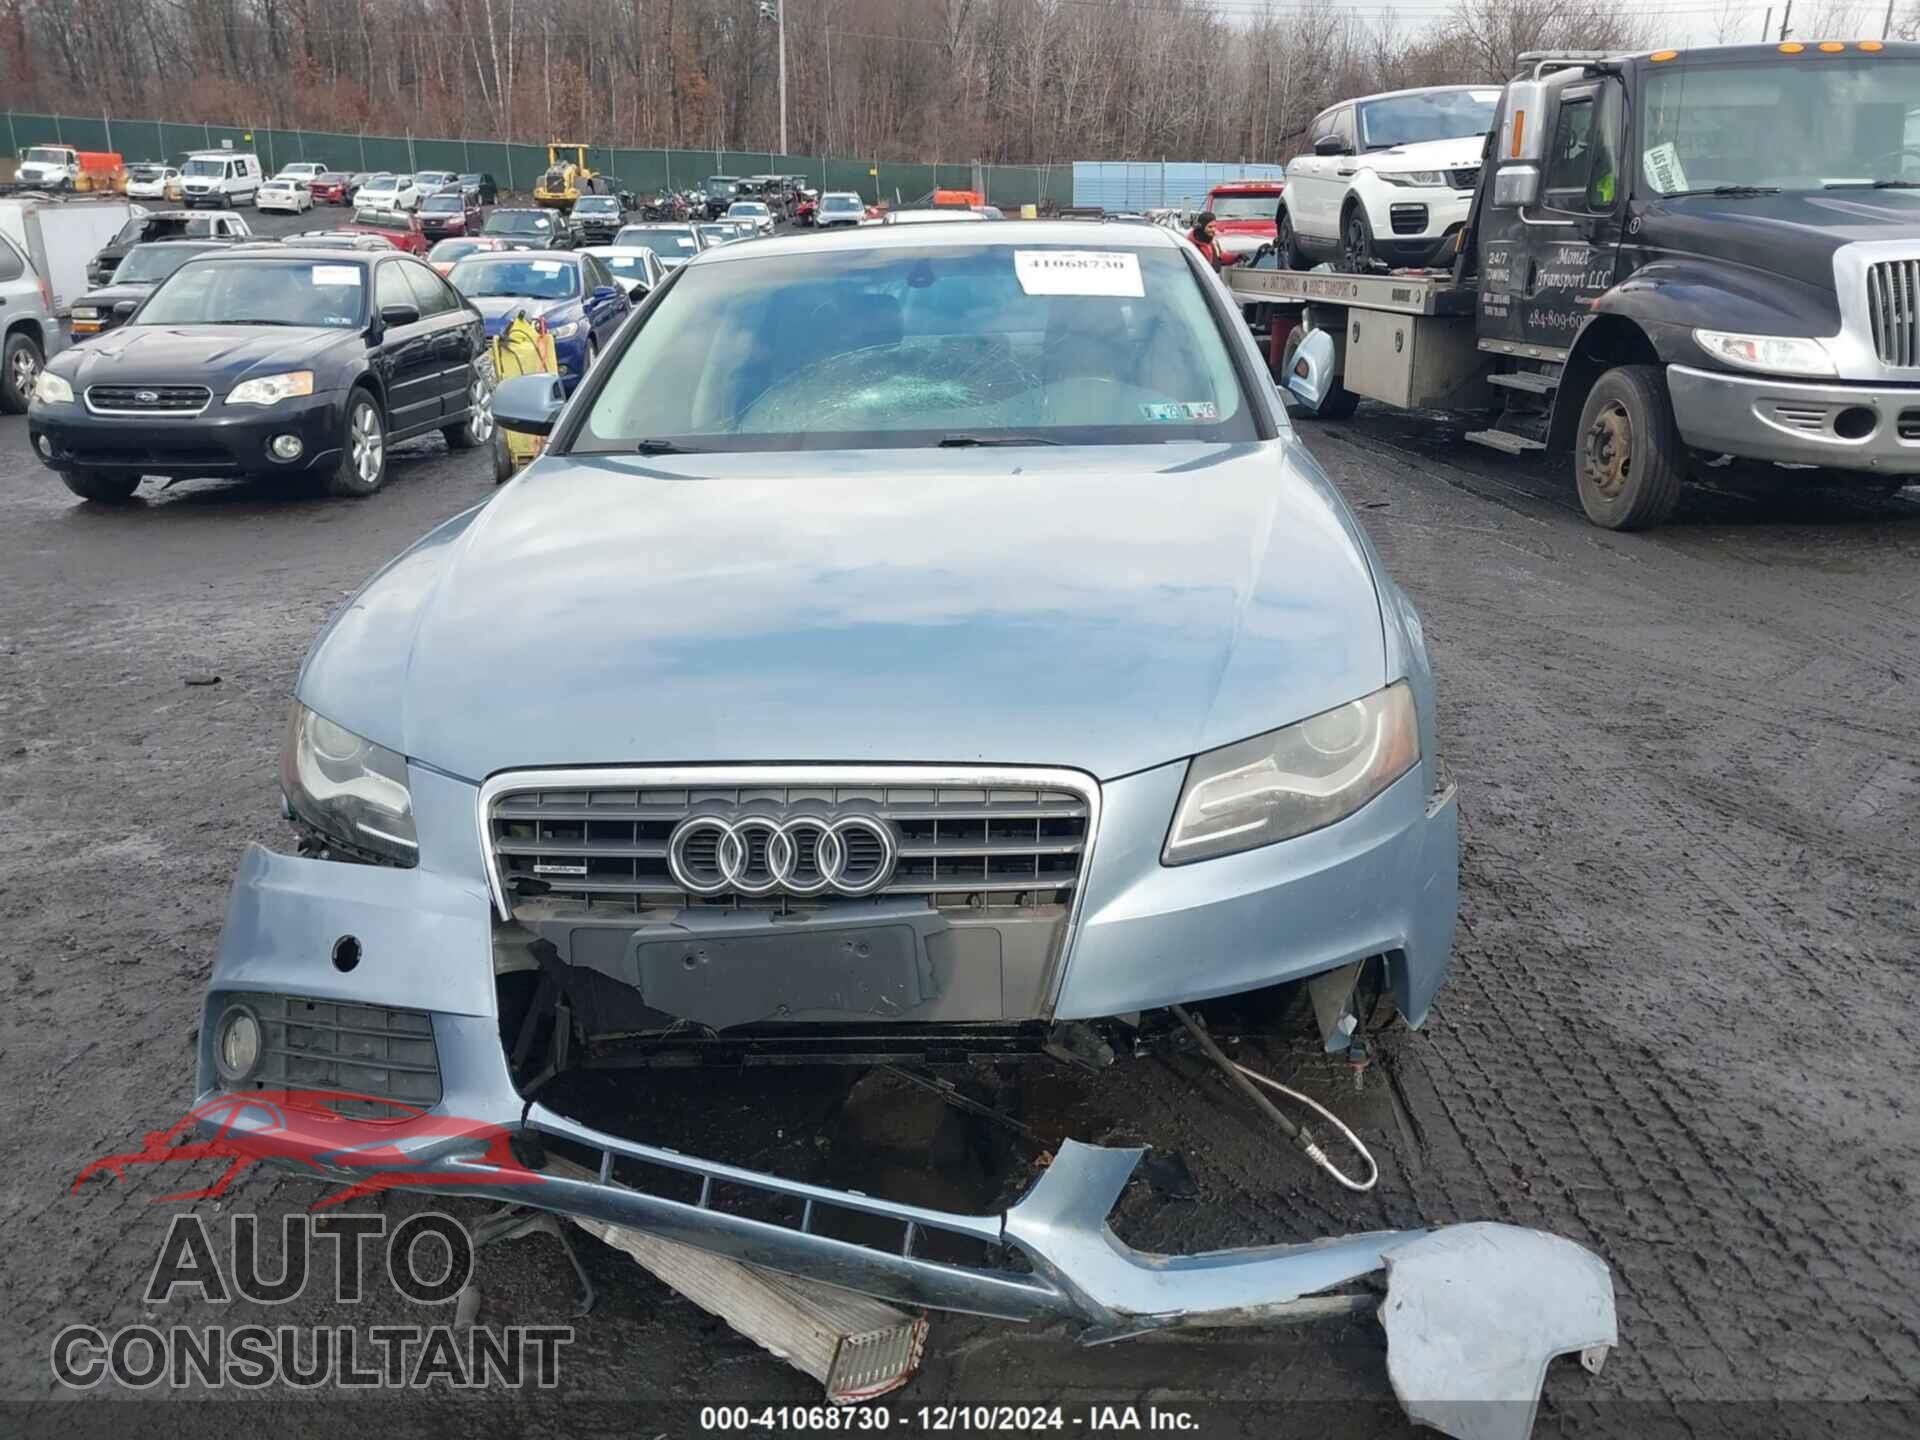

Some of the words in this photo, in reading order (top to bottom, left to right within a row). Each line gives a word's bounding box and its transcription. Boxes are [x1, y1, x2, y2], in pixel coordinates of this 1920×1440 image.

[1650, 149, 1667, 166] LAS
[1488, 252, 1508, 265] 24/7
[1556, 247, 1590, 265] Monet
[1536, 269, 1586, 294] Transport
[1587, 270, 1612, 289] LLC
